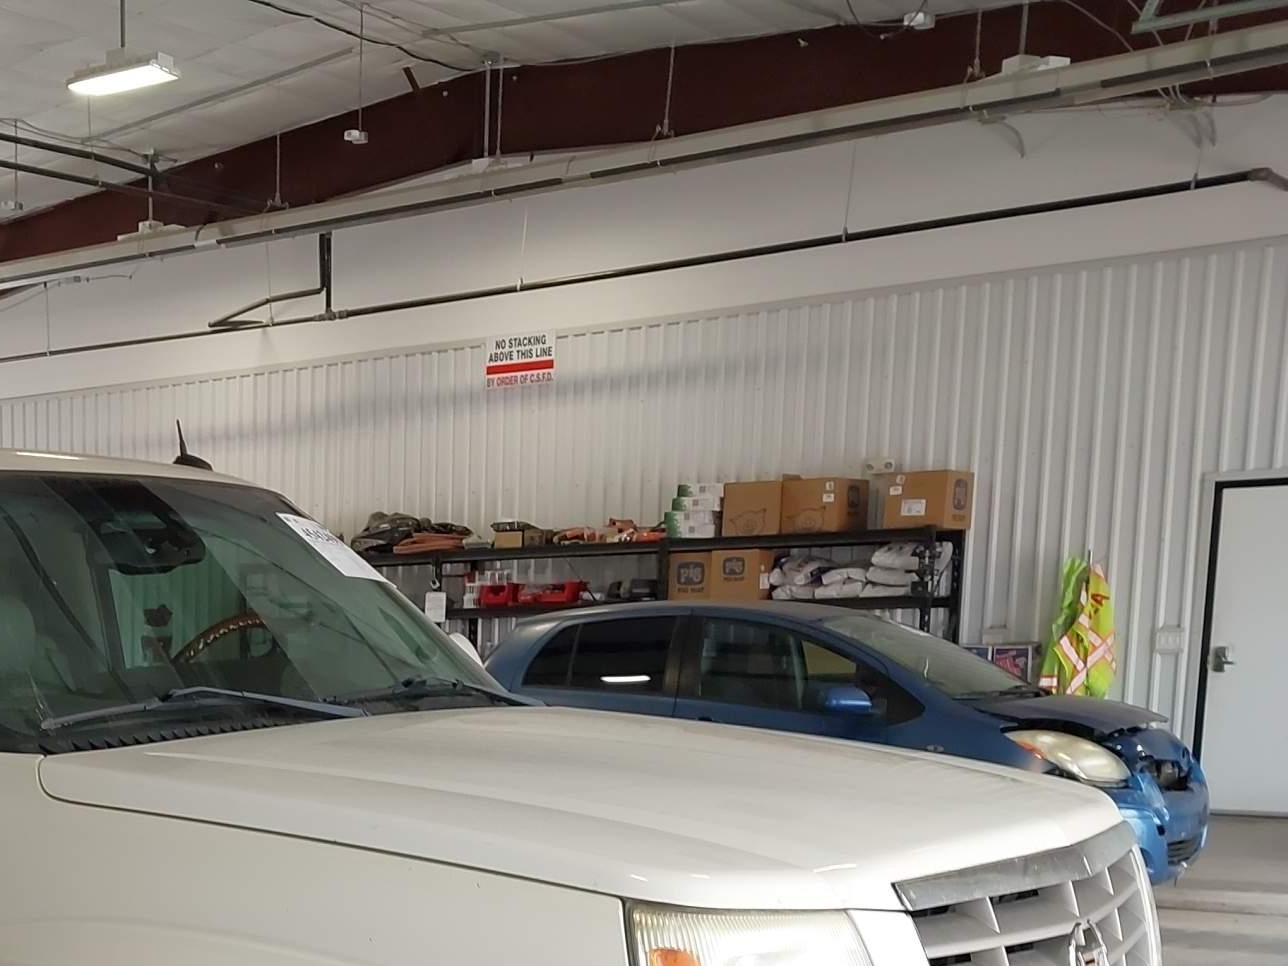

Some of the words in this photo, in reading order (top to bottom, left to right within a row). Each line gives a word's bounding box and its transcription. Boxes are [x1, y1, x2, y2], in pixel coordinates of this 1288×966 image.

[495, 339, 506, 350] NO
[508, 334, 546, 348] STACKING
[488, 350, 514, 363] ABOVE
[516, 348, 534, 360] THIS
[535, 346, 553, 358] LINE
[496, 375, 519, 387] ORDER
[519, 374, 529, 385] OF
